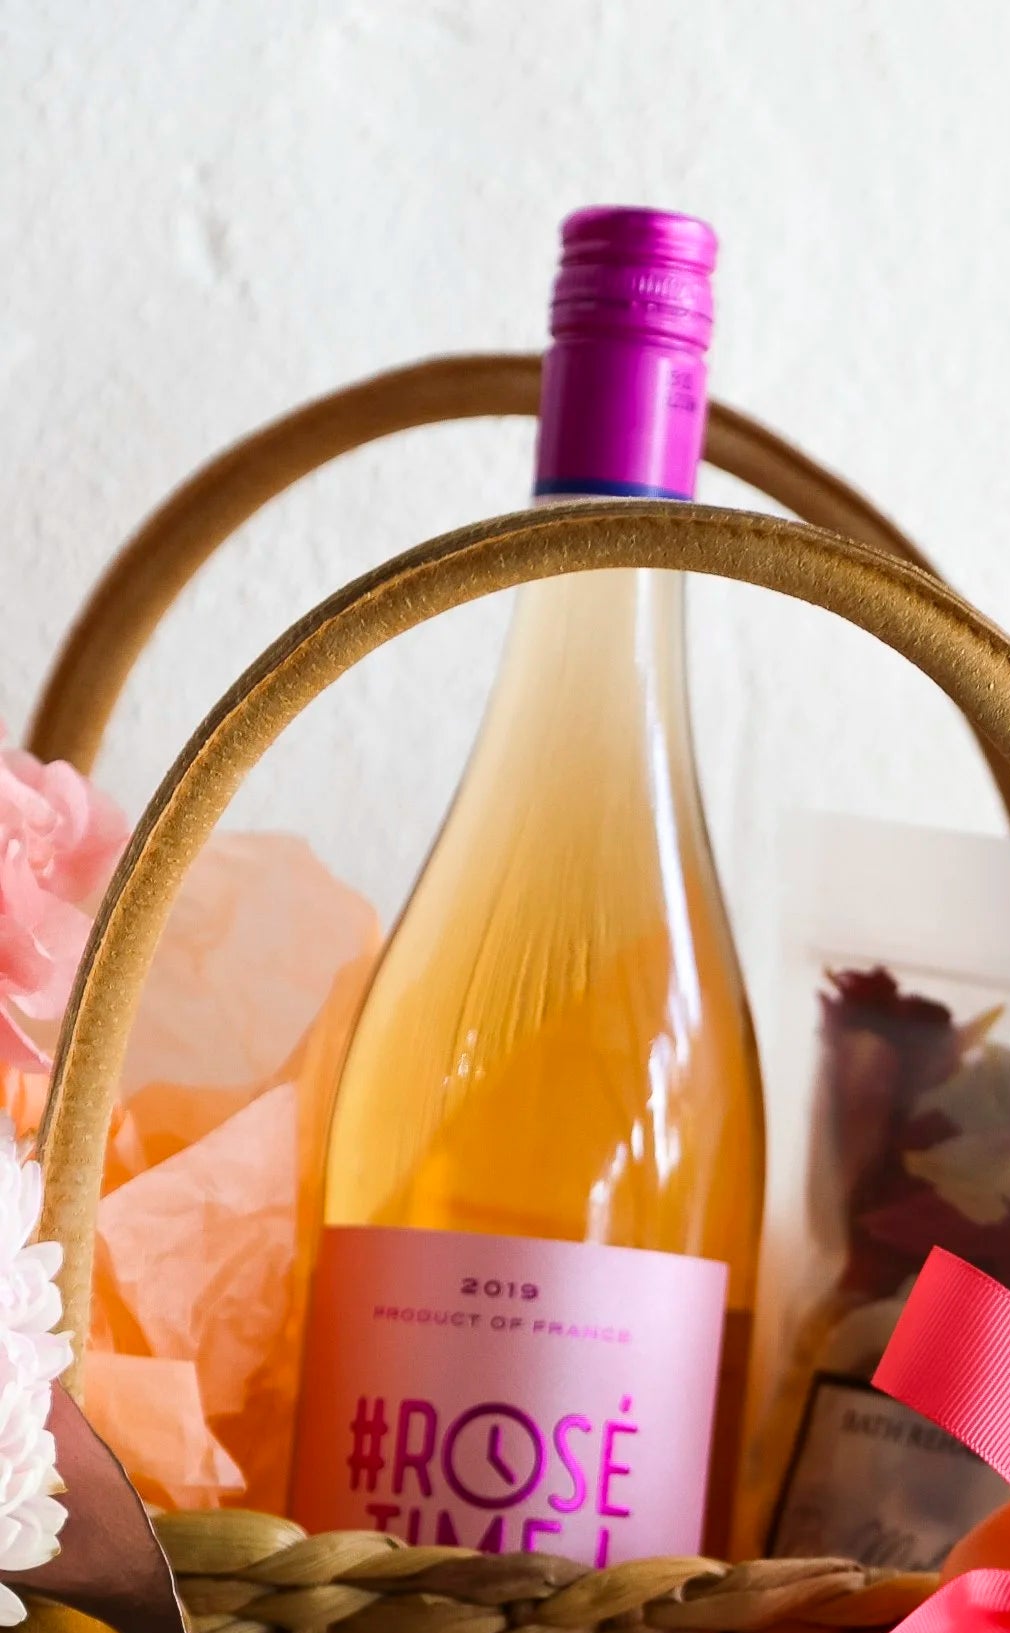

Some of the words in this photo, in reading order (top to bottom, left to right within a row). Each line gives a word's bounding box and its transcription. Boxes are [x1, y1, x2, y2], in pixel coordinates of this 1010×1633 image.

[460, 1276, 540, 1301] 2019
[373, 1305, 481, 1328] PRODUCT
[489, 1314, 523, 1332] OF
[532, 1319, 633, 1345] FRANCE
